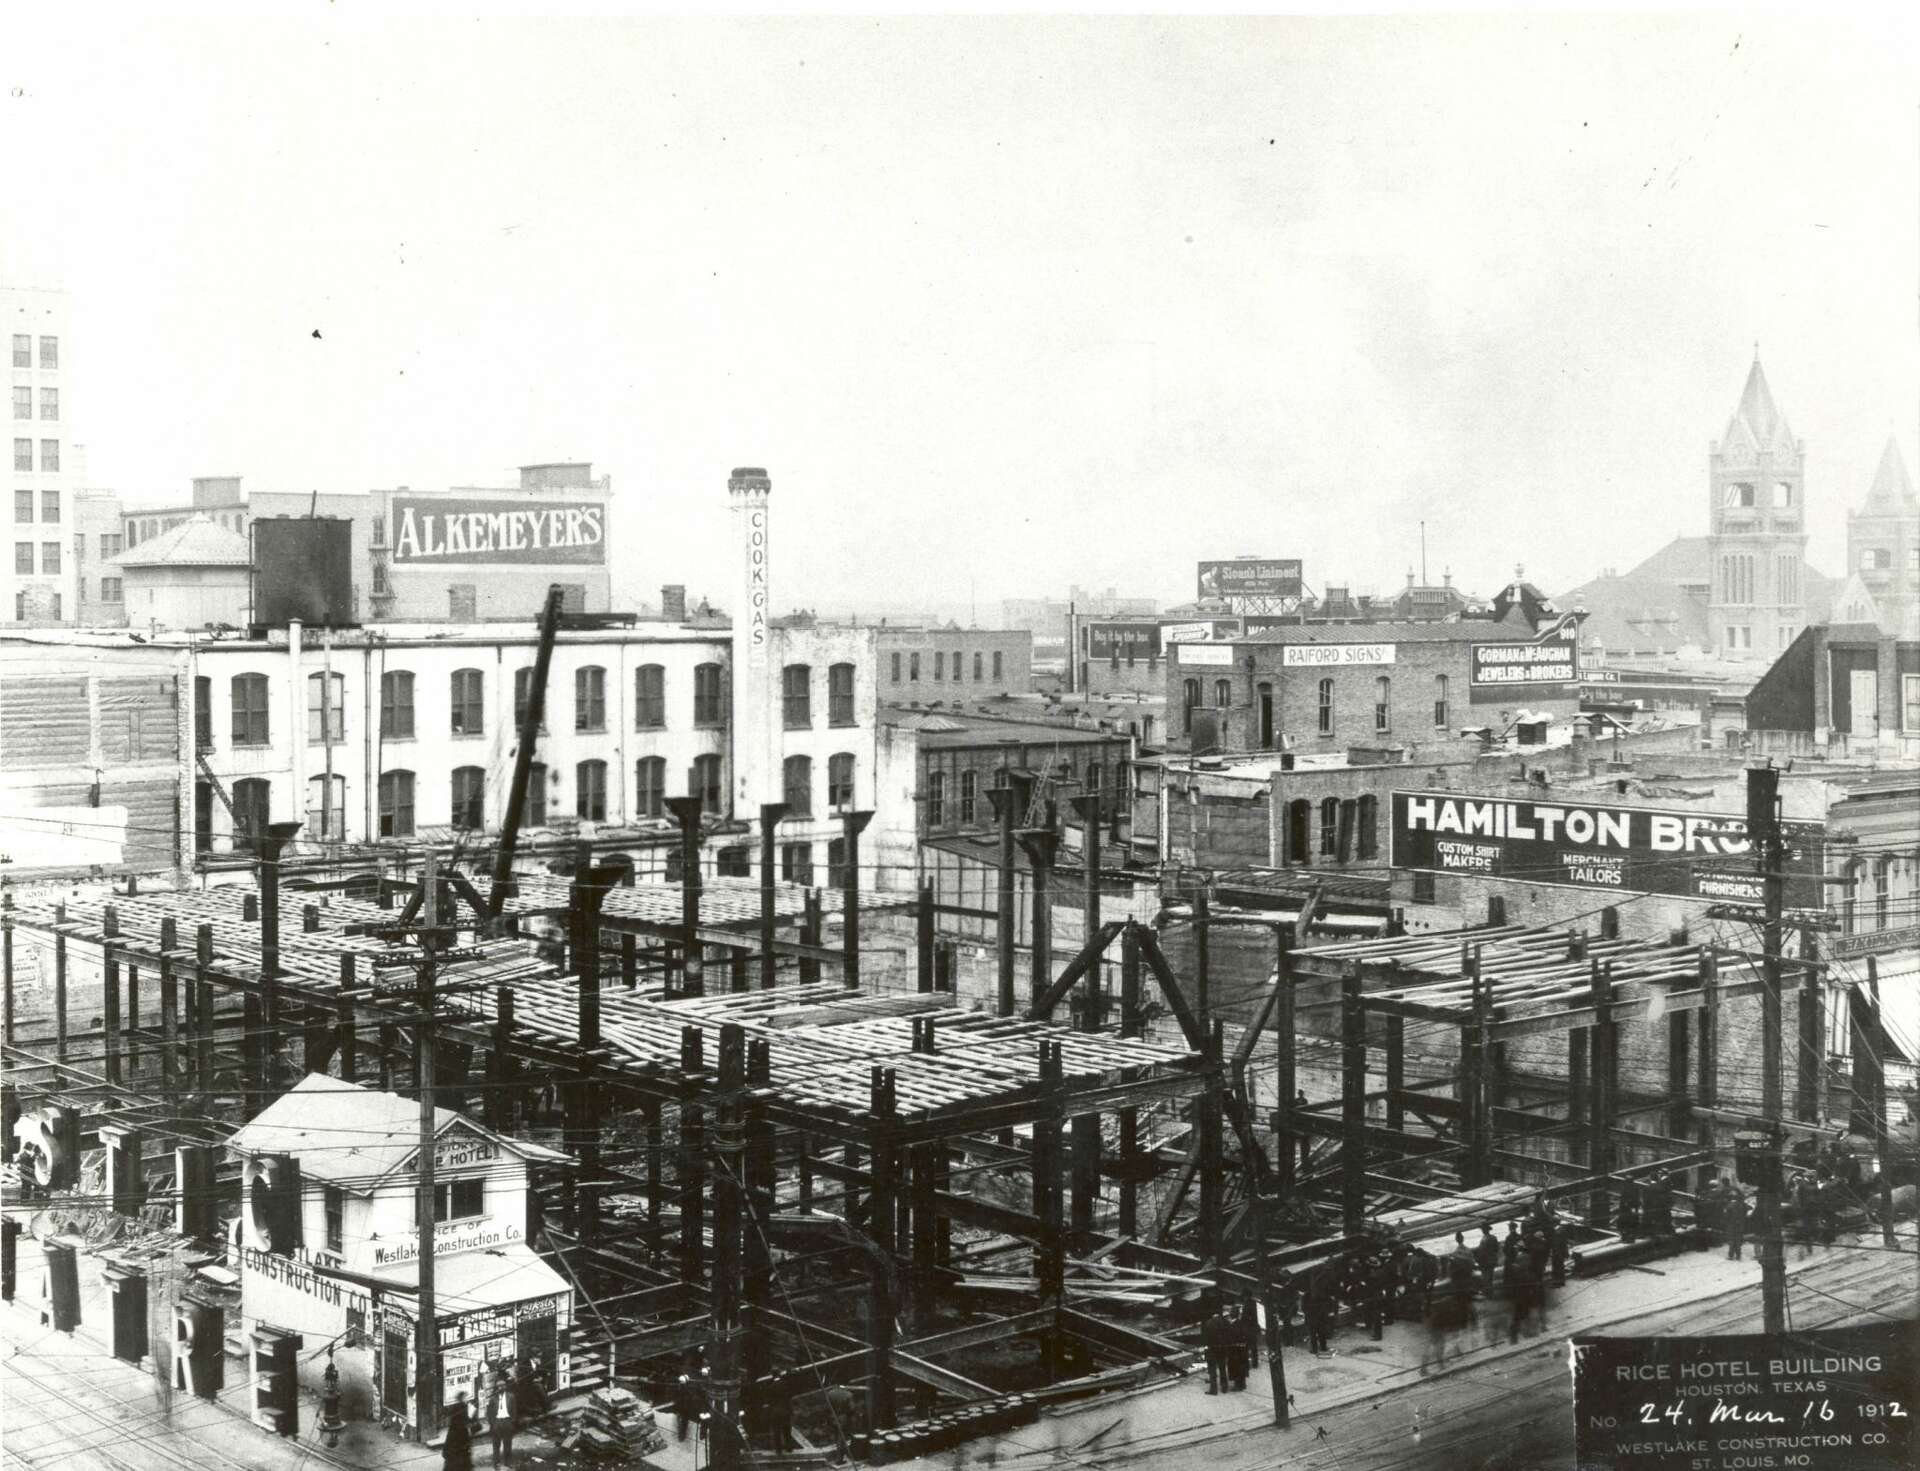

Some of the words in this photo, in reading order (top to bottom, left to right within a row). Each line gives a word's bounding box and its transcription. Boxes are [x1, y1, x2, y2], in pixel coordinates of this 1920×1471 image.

[394, 507, 602, 558] ALKEMEYER'S
[752, 512, 763, 583] COOK
[752, 592, 764, 645] GAS
[1559, 627, 1576, 640] 910
[1288, 648, 1340, 663] RAIFORD
[1477, 666, 1524, 682] JEWELERS
[1530, 665, 1573, 681] BROKERS
[1407, 797, 1631, 848] HAMILTON
[1437, 842, 1474, 856] CUSTOM
[1475, 844, 1501, 859] SHIRT
[1443, 854, 1492, 871] MAKERS
[1569, 866, 1622, 885] TAILORS
[1699, 881, 1764, 898] FURNISHERS
[450, 1144, 493, 1165] HOTEL
[432, 1231, 500, 1255] onstruction
[505, 1224, 522, 1240] Co.
[245, 1248, 342, 1307] CONSTRUCTION
[438, 1325, 461, 1346] THE
